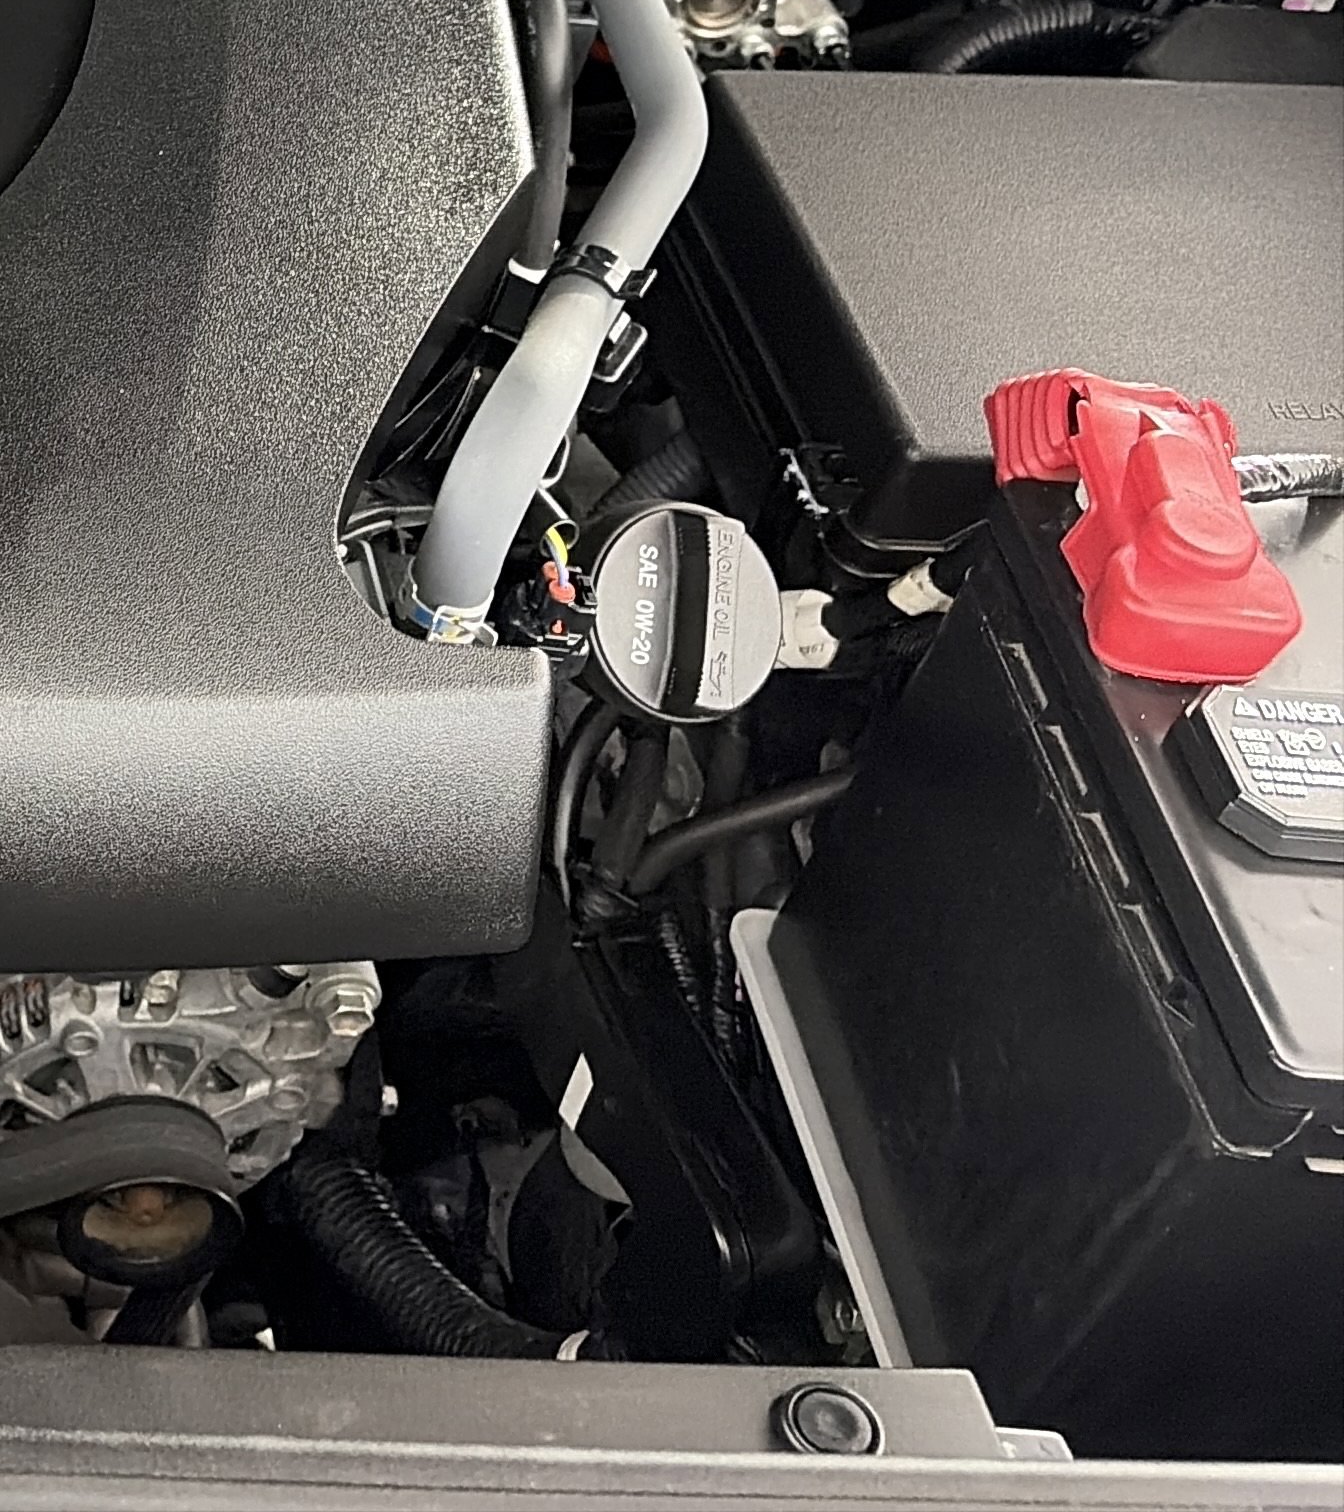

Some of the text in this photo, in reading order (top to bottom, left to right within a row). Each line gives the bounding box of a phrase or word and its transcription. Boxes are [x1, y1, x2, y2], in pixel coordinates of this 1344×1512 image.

[629, 543, 659, 666] SAE 0W-20
[712, 528, 734, 642] ENGINE OIL
[1230, 727, 1275, 743] SHIELD
[1256, 698, 1344, 725] DANGER
